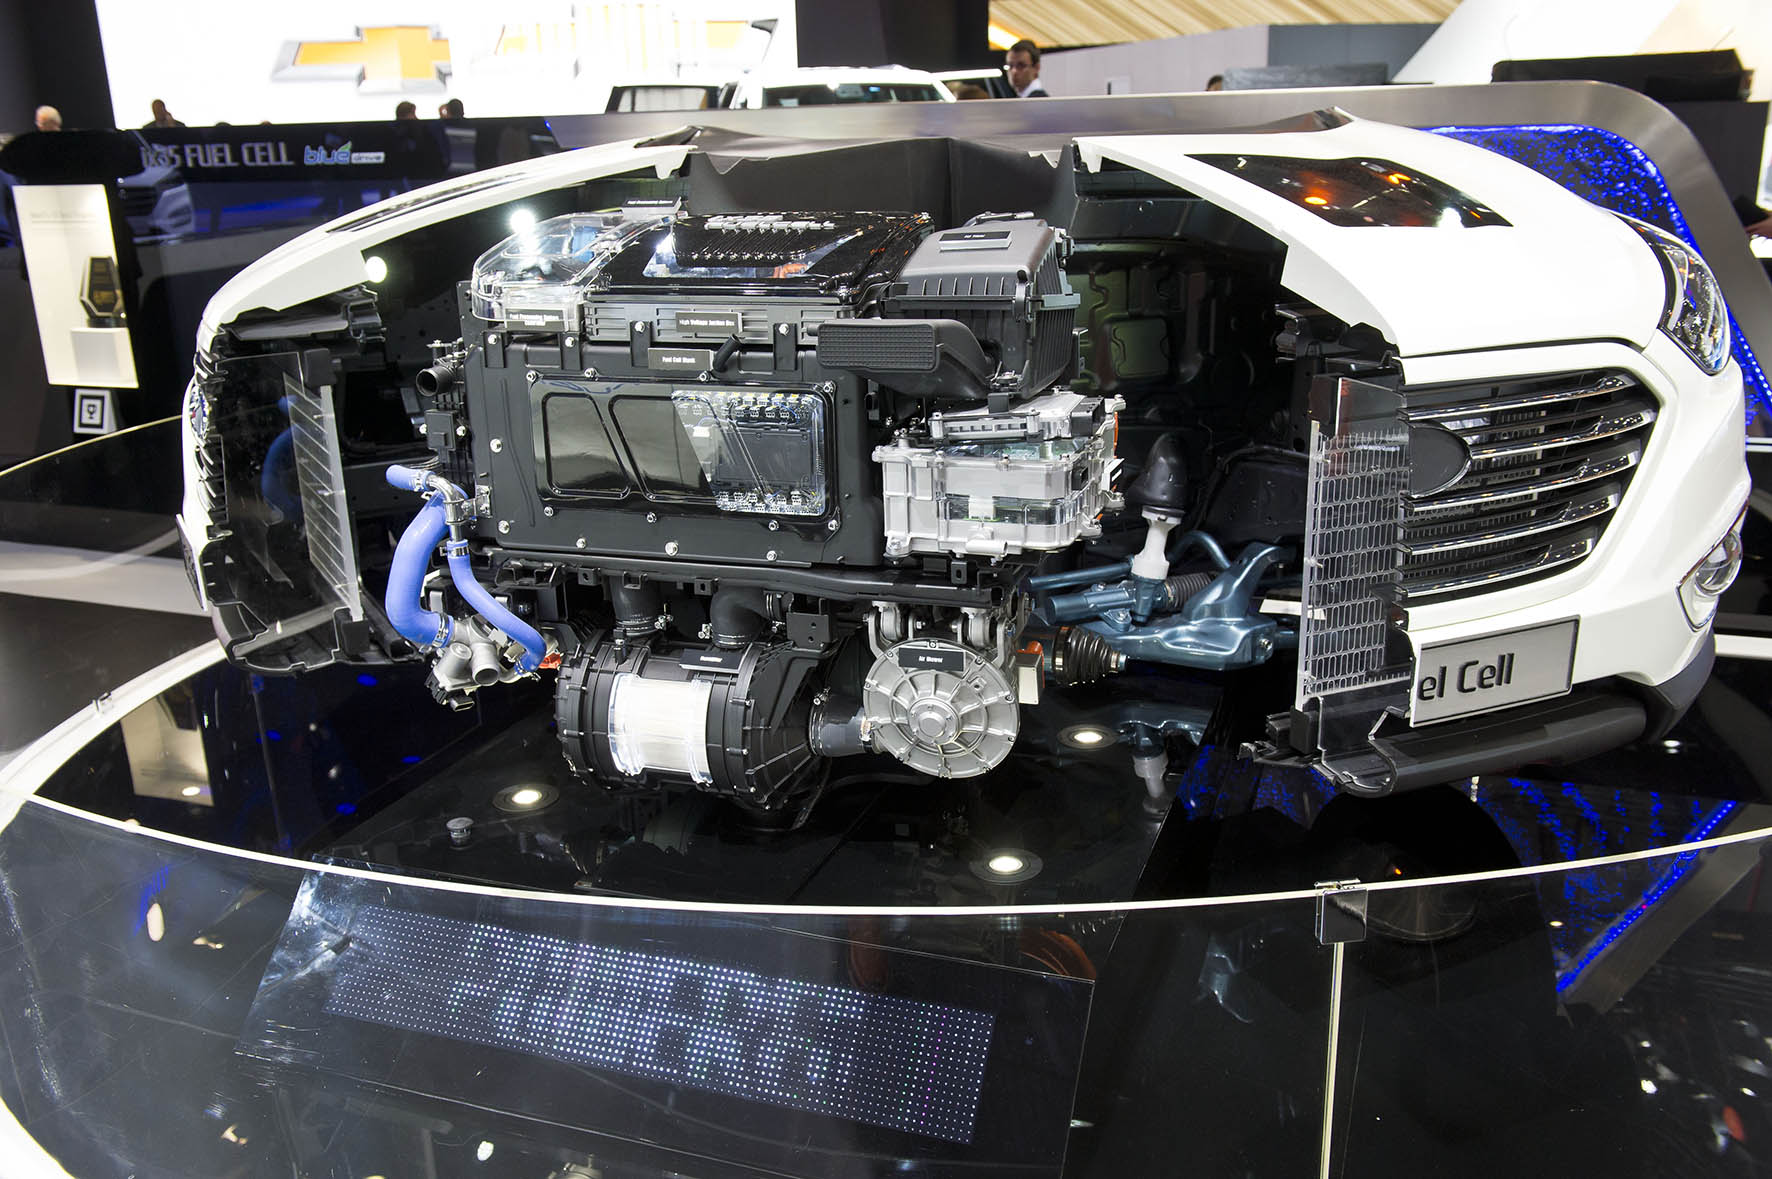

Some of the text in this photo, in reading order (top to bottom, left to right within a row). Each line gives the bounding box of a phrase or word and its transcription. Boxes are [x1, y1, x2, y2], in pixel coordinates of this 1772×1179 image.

[184, 143, 239, 168] FUEL
[241, 141, 295, 166] CELL
[303, 143, 351, 165] blue
[1457, 652, 1515, 693] Cell
